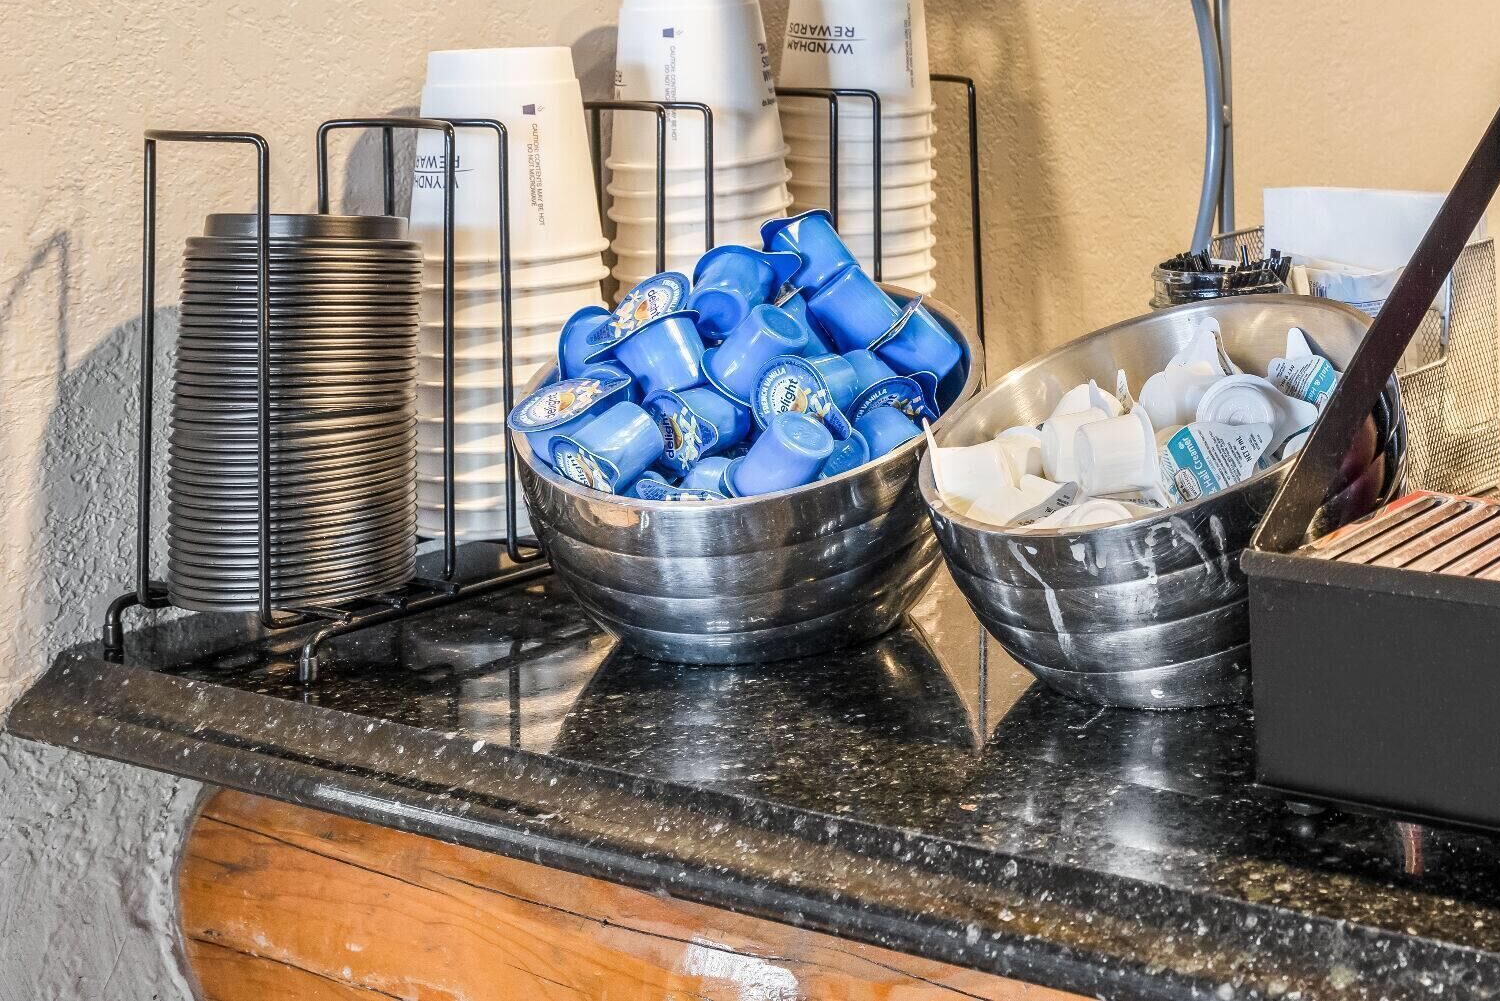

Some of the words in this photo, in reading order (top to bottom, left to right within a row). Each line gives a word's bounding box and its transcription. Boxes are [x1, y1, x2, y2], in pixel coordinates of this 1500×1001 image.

[790, 22, 855, 38] REWARDS
[787, 40, 854, 55] WYNDHAM
[664, 411, 676, 459] delight
[1182, 437, 1203, 470] Creamer
[1243, 453, 1253, 462] NET
[1199, 468, 1213, 488] Half
